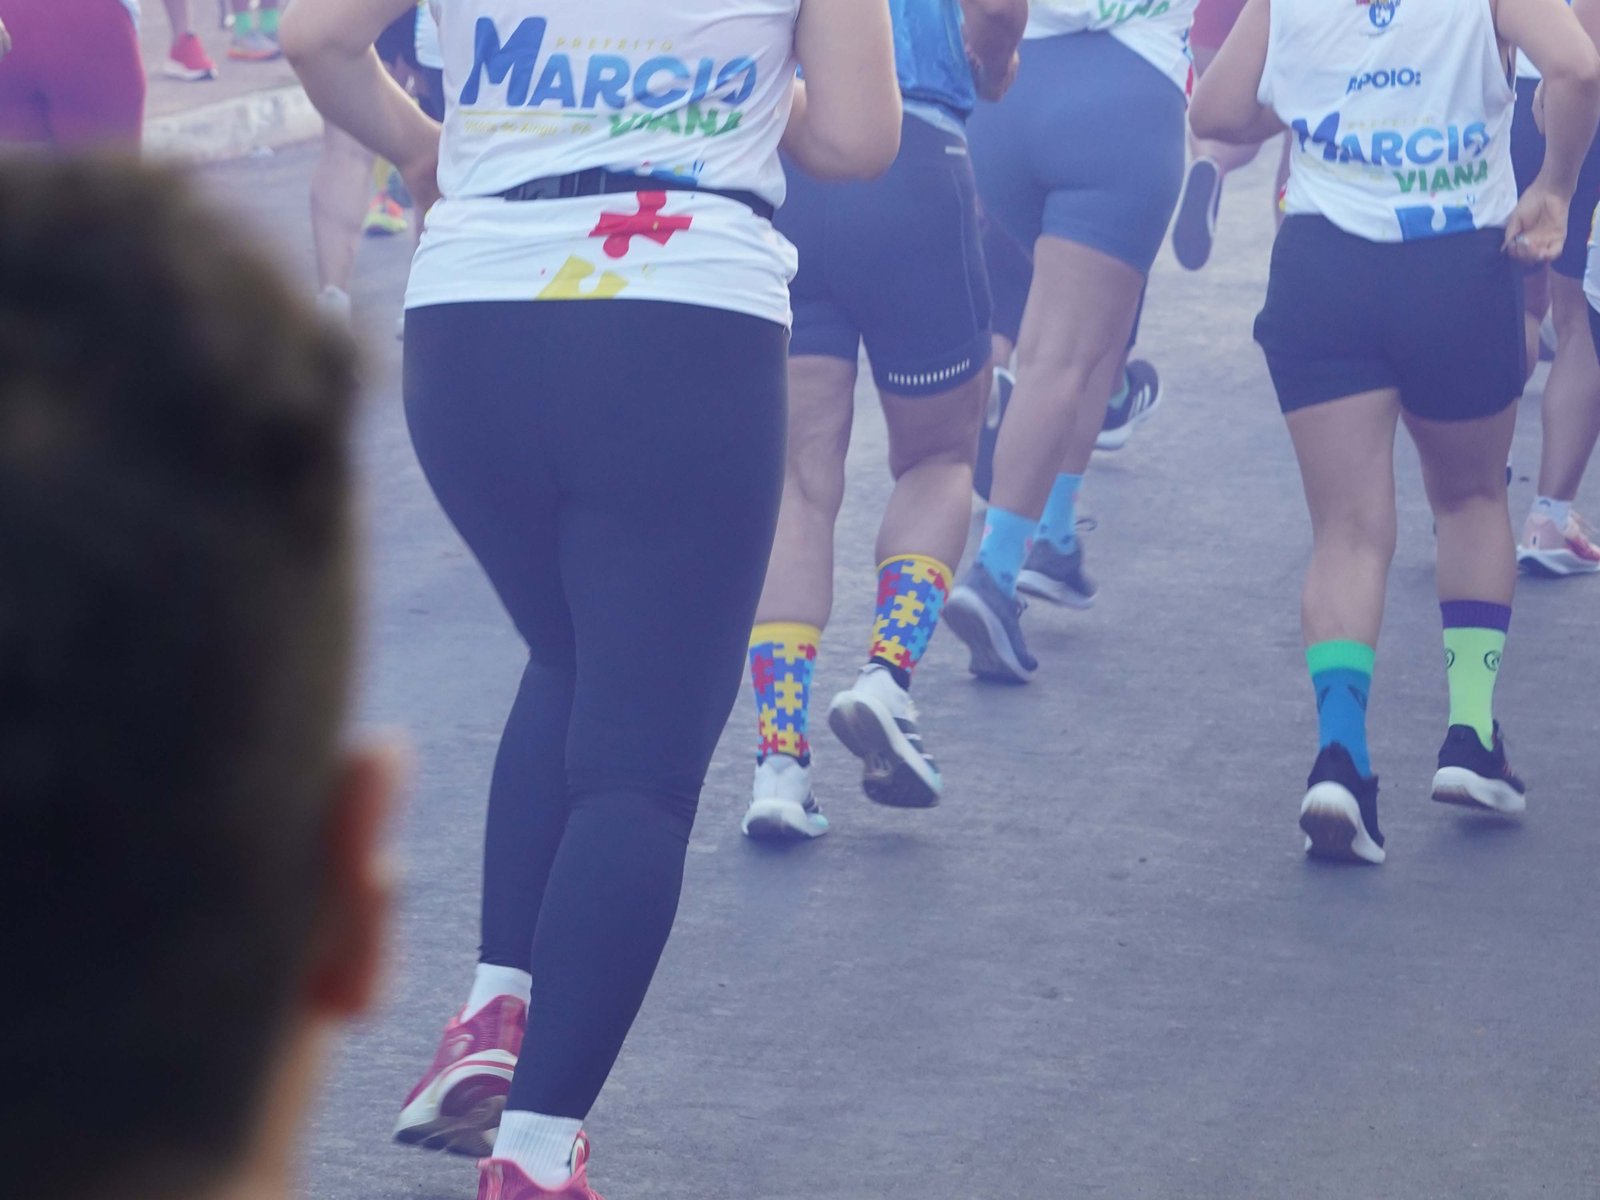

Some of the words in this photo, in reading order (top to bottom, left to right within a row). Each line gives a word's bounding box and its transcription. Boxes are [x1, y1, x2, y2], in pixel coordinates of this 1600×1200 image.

[459, 16, 757, 109] MARCIO
[1346, 68, 1421, 94] APOIO:
[1291, 112, 1490, 167] MARCIO
[1393, 159, 1488, 193] VIANA
